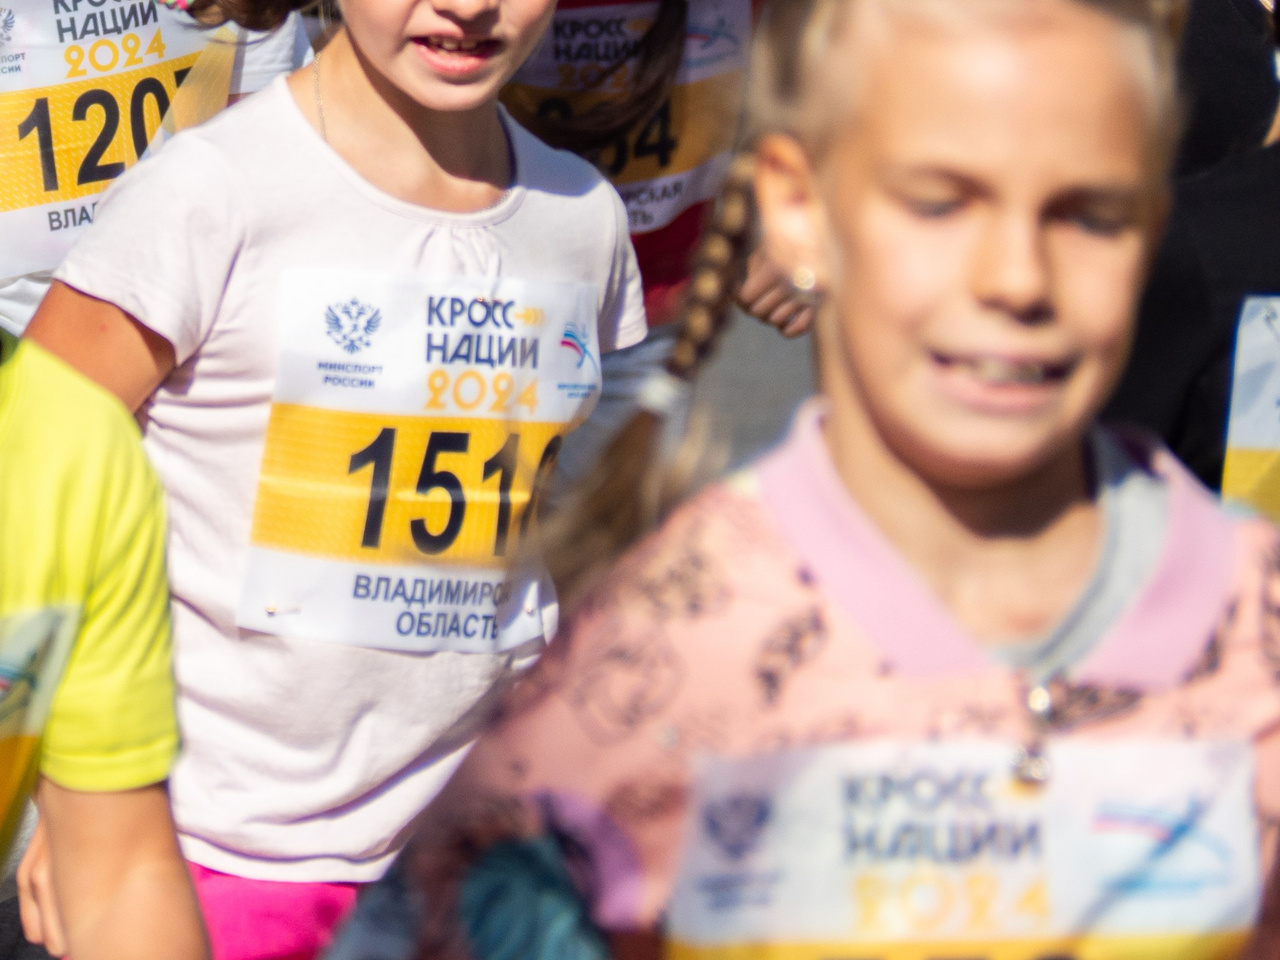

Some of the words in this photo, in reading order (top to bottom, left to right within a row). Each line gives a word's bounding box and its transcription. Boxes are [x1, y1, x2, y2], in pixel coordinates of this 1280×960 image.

[63, 25, 167, 80] 2024
[17, 66, 195, 193] 120
[426, 295, 516, 330] КРОСС
[317, 361, 384, 376] МИНСПОРТ
[425, 333, 539, 370] НАЦИИ
[323, 375, 376, 389] РОССИИ
[423, 370, 540, 417] 2024
[843, 819, 1043, 865] НАЦИИ
